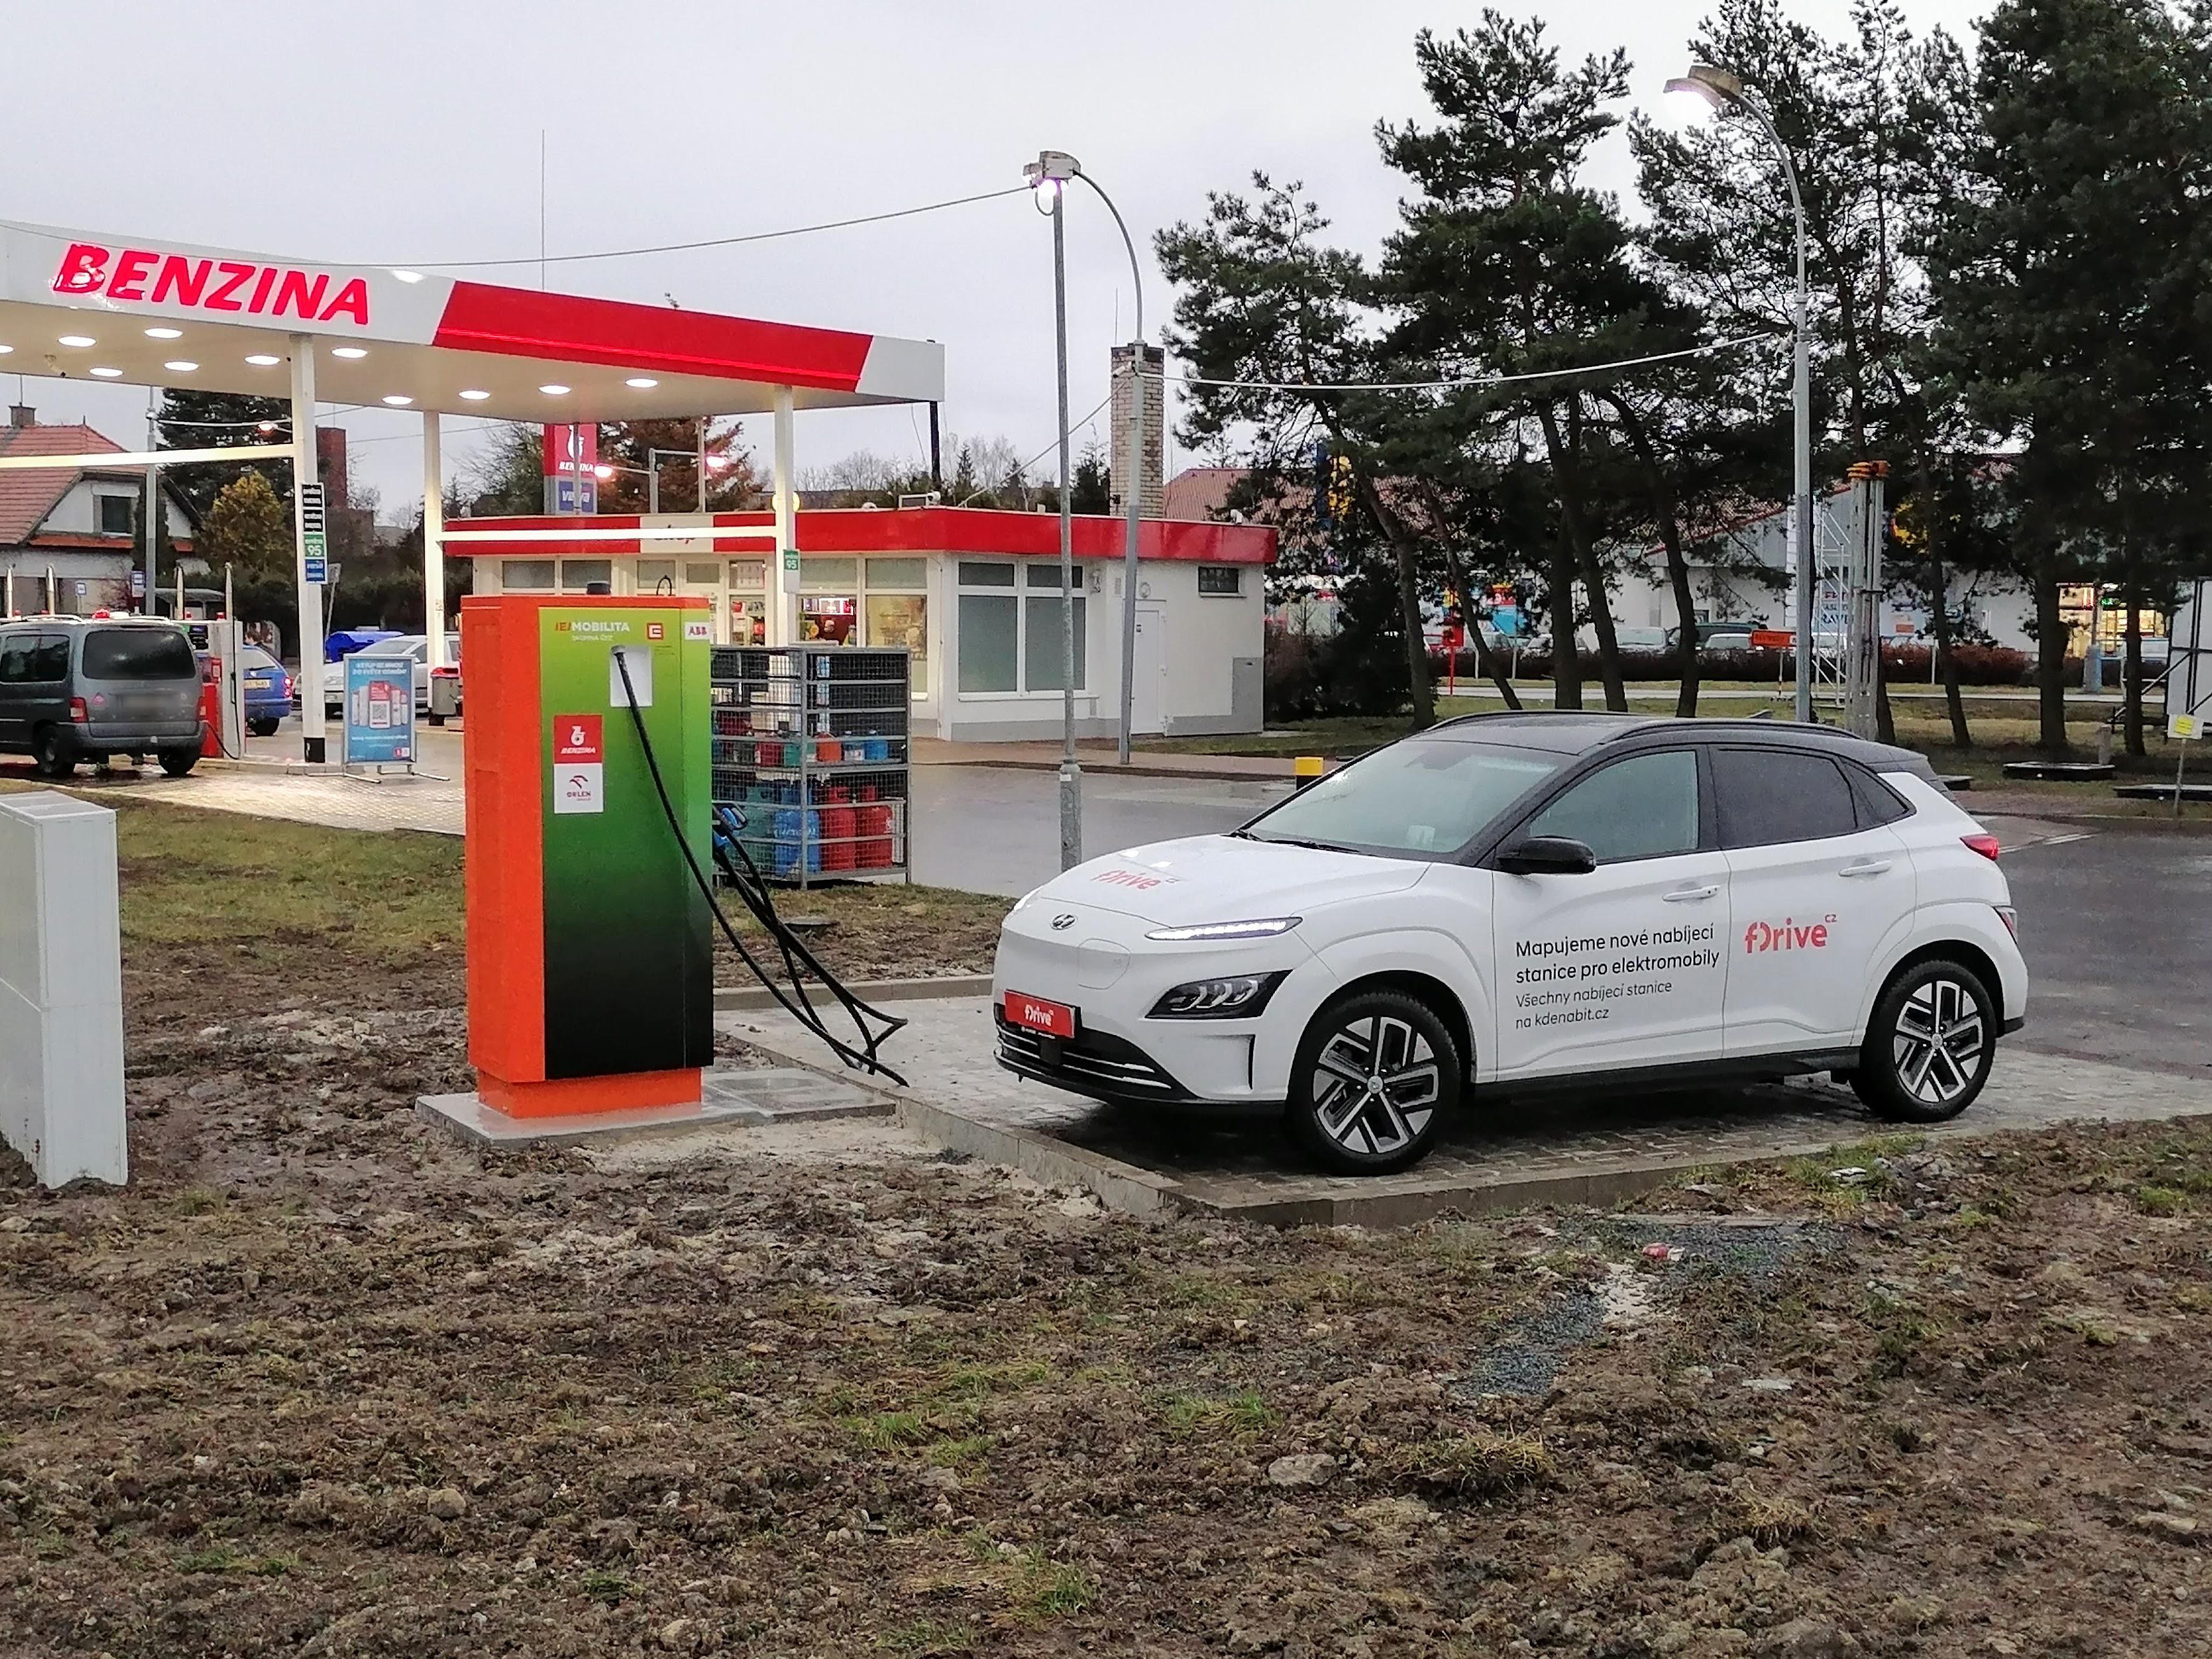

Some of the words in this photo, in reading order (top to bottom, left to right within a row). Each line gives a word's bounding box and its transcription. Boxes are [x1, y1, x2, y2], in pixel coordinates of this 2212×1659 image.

[52, 243, 369, 325] BENZINA
[559, 461, 594, 472] BENINA
[307, 545, 323, 556] 95
[786, 560, 797, 569] 95
[689, 627, 707, 635] ABB
[1516, 936, 1605, 958] Mapujeme
[1610, 929, 1648, 948] nové
[1653, 922, 1714, 945] nabíjecí
[1516, 964, 1576, 983] stanice
[1581, 963, 1608, 980] pro
[1612, 949, 1720, 973] elektromobily
[1516, 990, 1570, 1008] Všechny
[1573, 984, 1624, 1001] nabíjecí
[1627, 980, 1672, 996] stanice
[1516, 1017, 1531, 1029] na
[1535, 1008, 1609, 1025] kdenabit.cz
